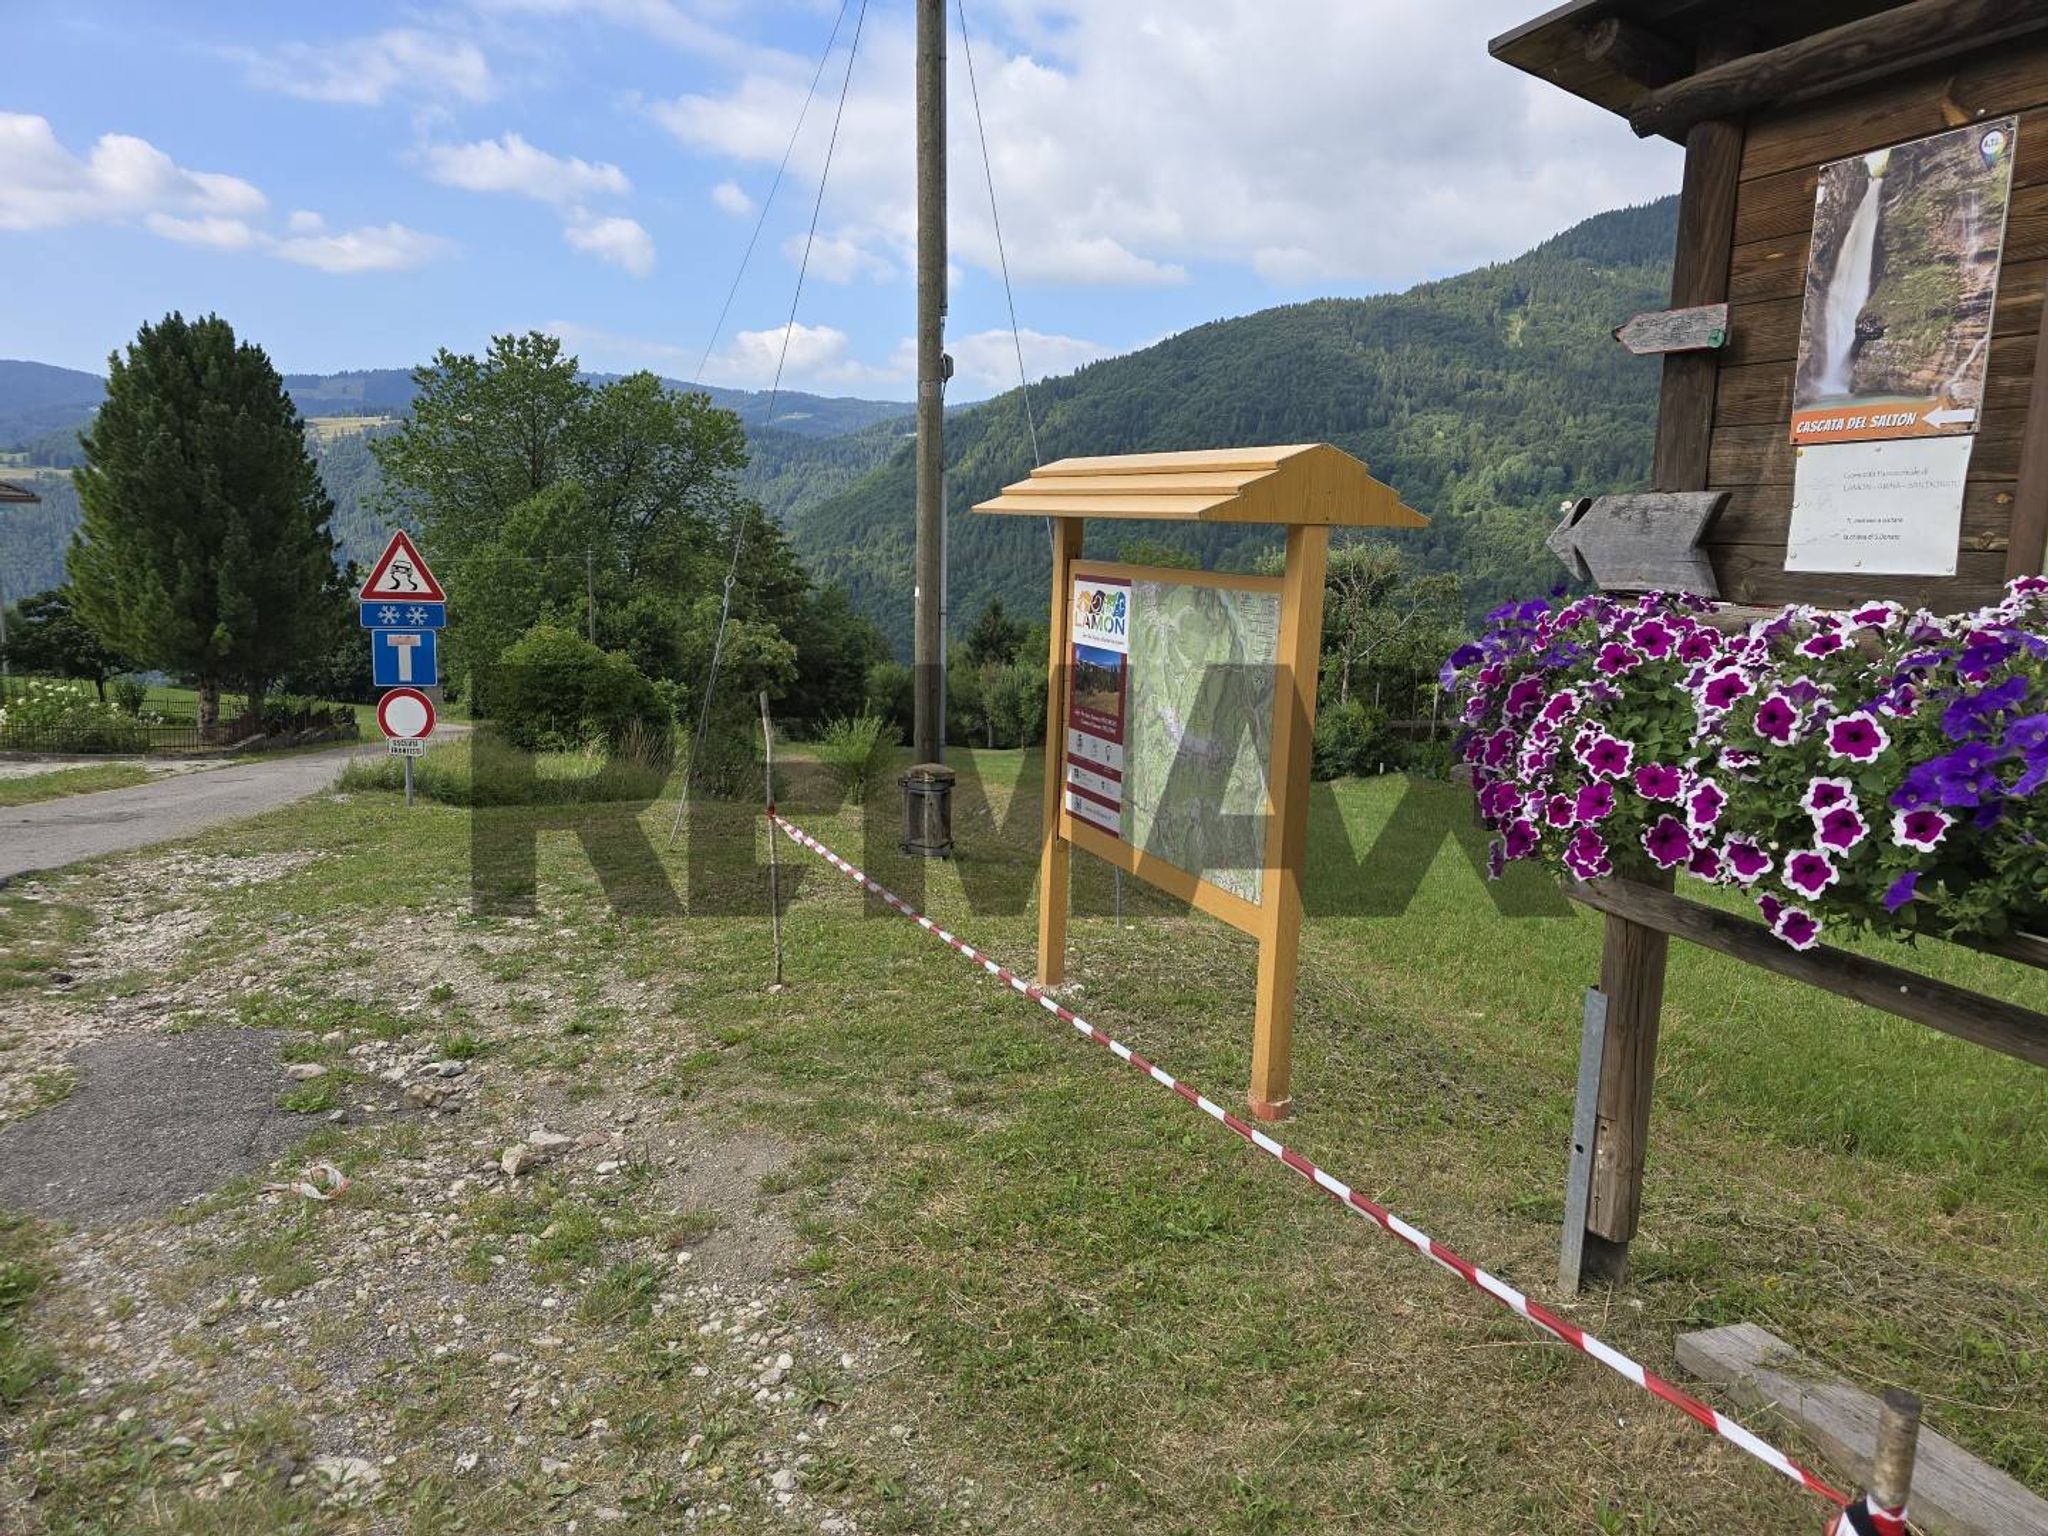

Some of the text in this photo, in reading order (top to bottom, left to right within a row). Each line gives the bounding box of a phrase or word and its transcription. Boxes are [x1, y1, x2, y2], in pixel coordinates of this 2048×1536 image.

[1796, 412, 1917, 434] CASCATA DEL SALTON
[1075, 611, 1125, 636] LAMON
